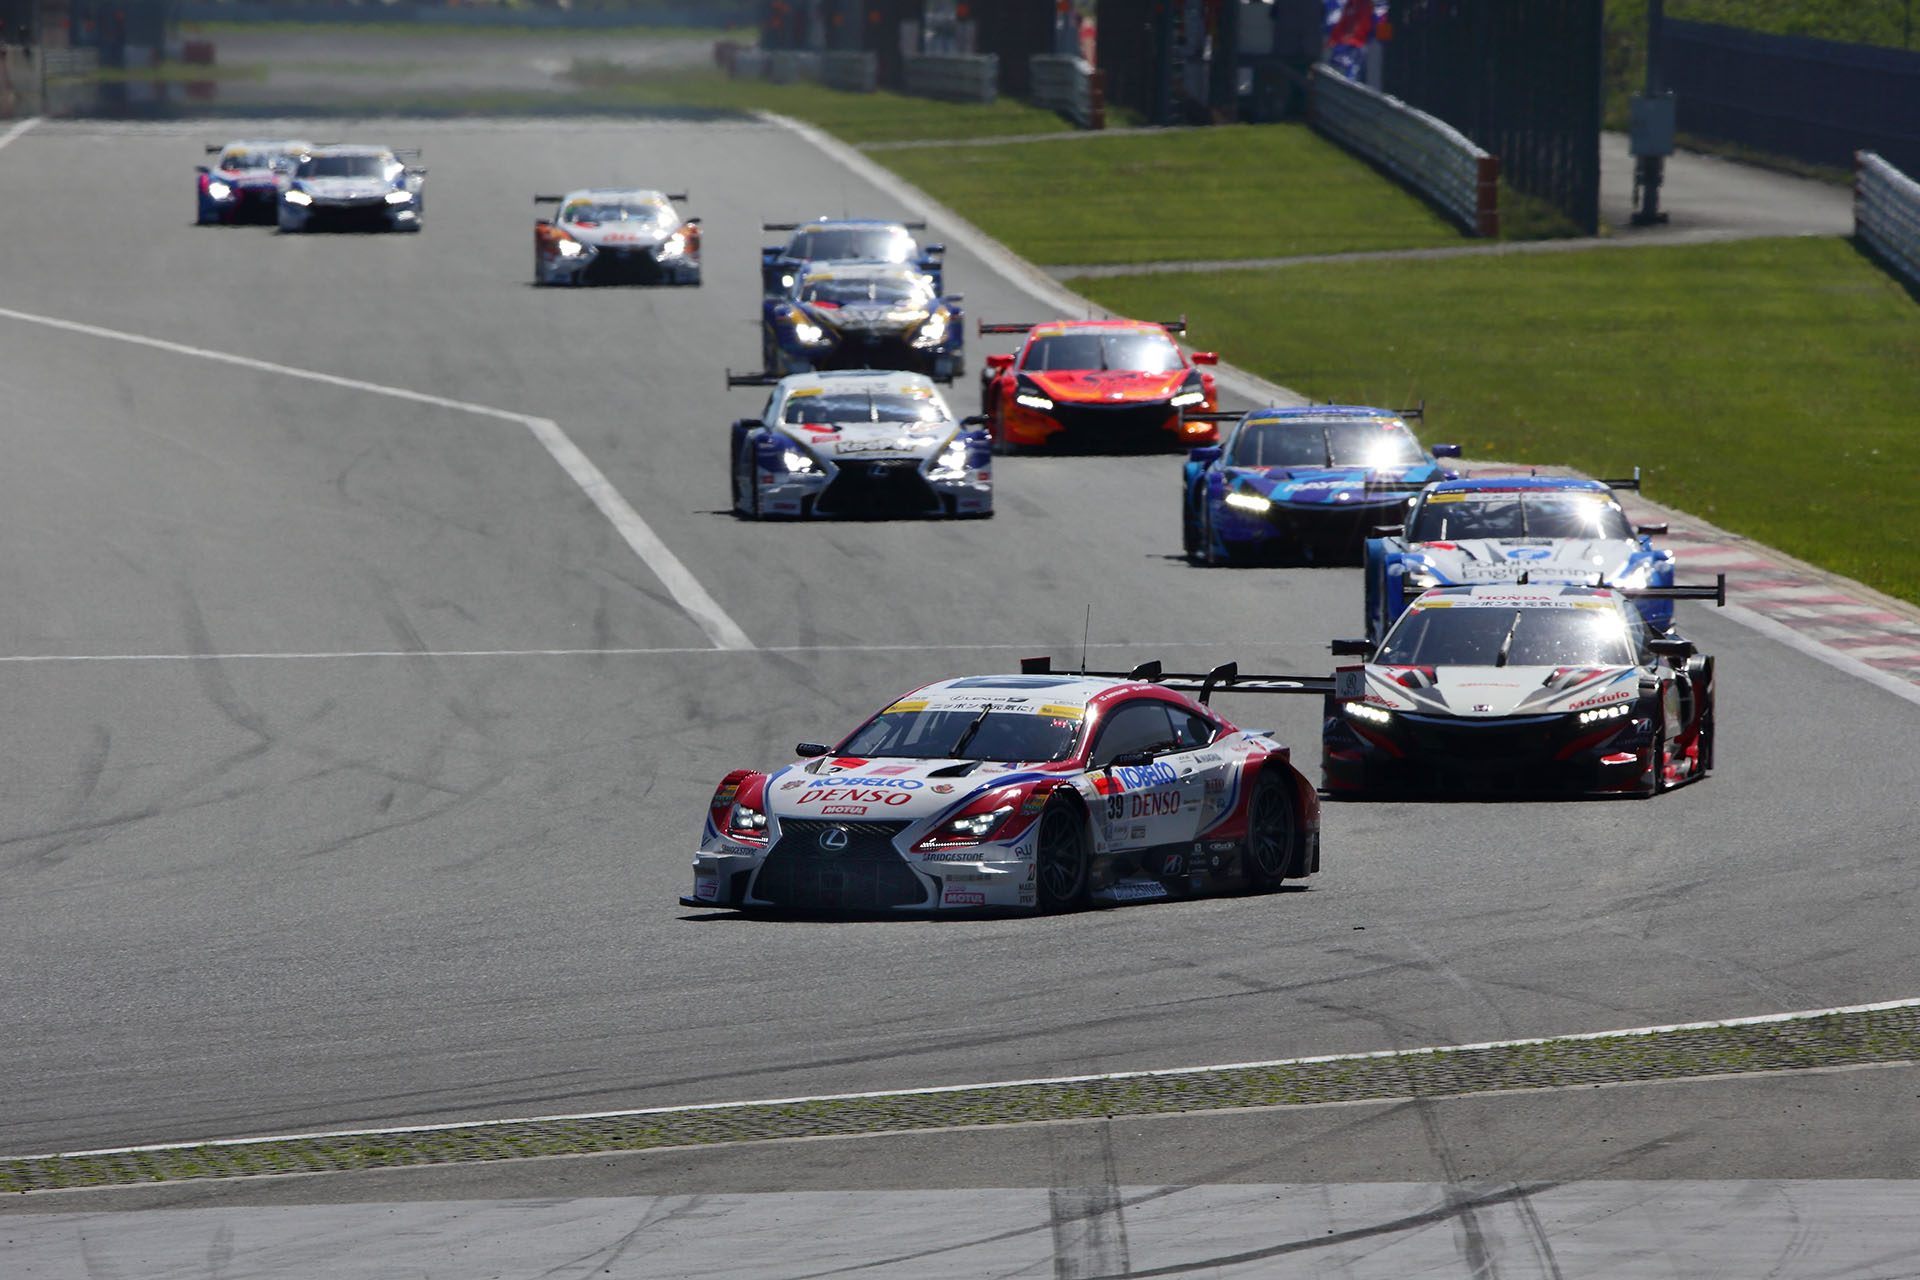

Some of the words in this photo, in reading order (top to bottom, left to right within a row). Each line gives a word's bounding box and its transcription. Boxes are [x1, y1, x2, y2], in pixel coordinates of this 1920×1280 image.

[1568, 691, 1630, 710] Modulo
[808, 777, 924, 790] KOBELCO
[1115, 761, 1177, 790] KOBELCO
[796, 788, 912, 806] DENSO
[1131, 790, 1181, 818] DENSO
[824, 805, 865, 814] MOTUL
[1107, 794, 1124, 820] 39
[923, 852, 985, 861] BRIDGESTONE
[947, 893, 984, 903] MOTUL
